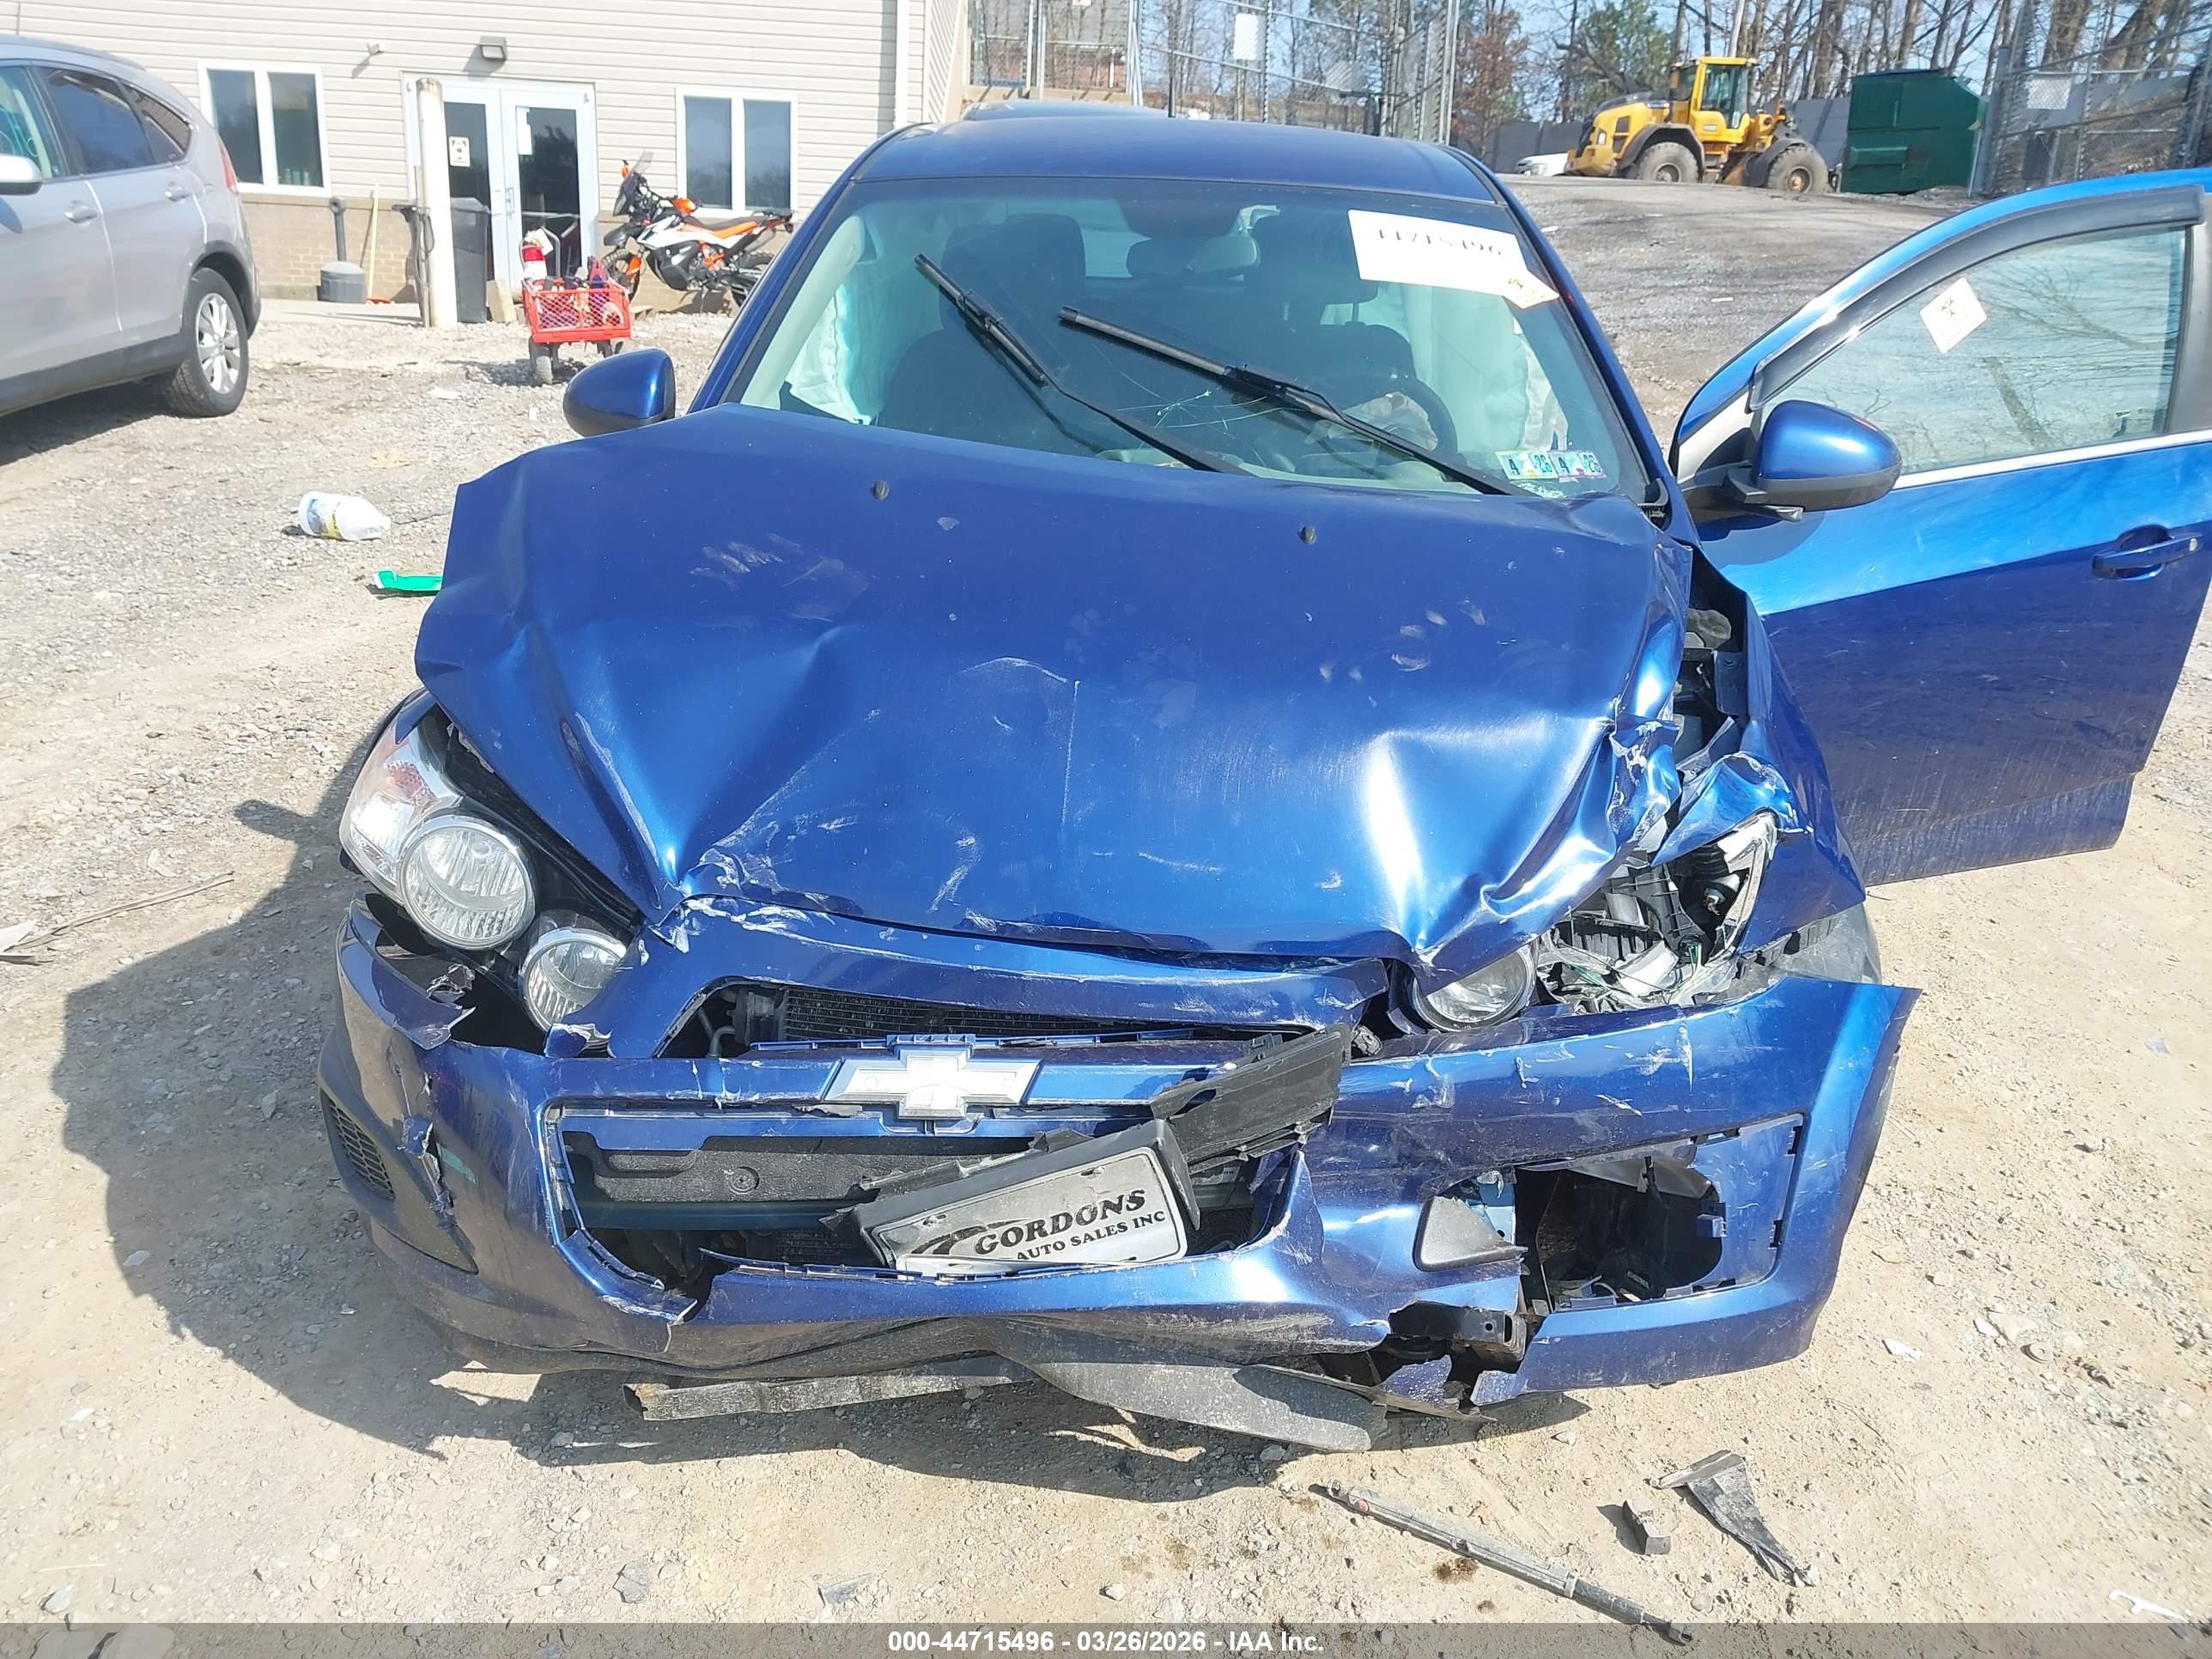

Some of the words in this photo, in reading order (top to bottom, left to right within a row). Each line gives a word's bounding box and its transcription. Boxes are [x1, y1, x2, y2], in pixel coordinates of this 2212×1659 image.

[1507, 458, 1521, 476] 4
[1557, 456, 1571, 474] 4
[975, 1188, 1146, 1255] GORDONS
[1017, 1240, 1066, 1261] AUTO
[1070, 1221, 1129, 1247] SALES
[1132, 1210, 1166, 1229] INC
